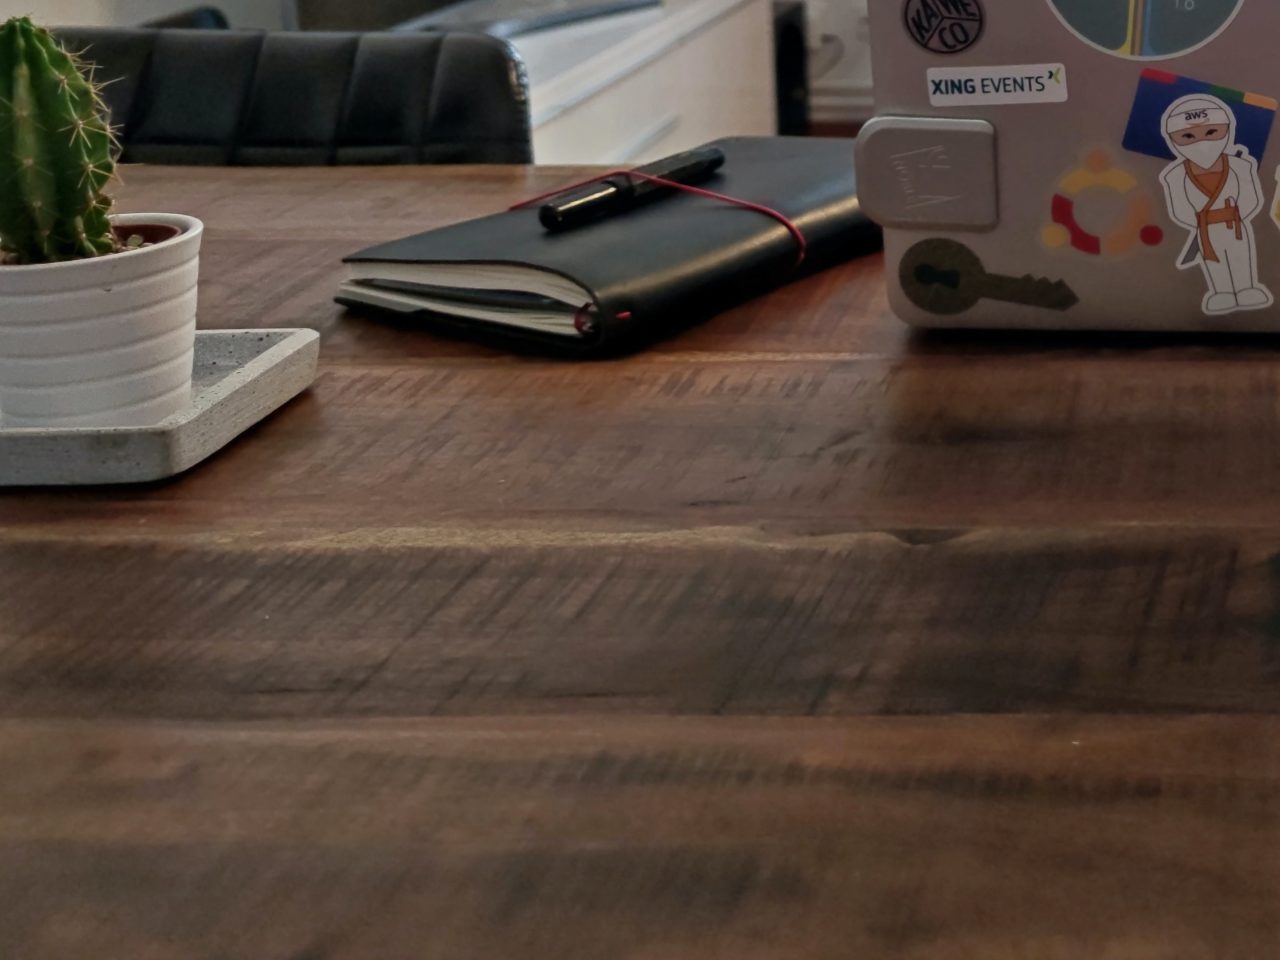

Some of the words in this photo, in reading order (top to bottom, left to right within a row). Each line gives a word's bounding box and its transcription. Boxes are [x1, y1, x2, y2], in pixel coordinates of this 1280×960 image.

[931, 78, 976, 95] XING
[981, 76, 1045, 94] EVENTS
[1184, 109, 1208, 121] aws
